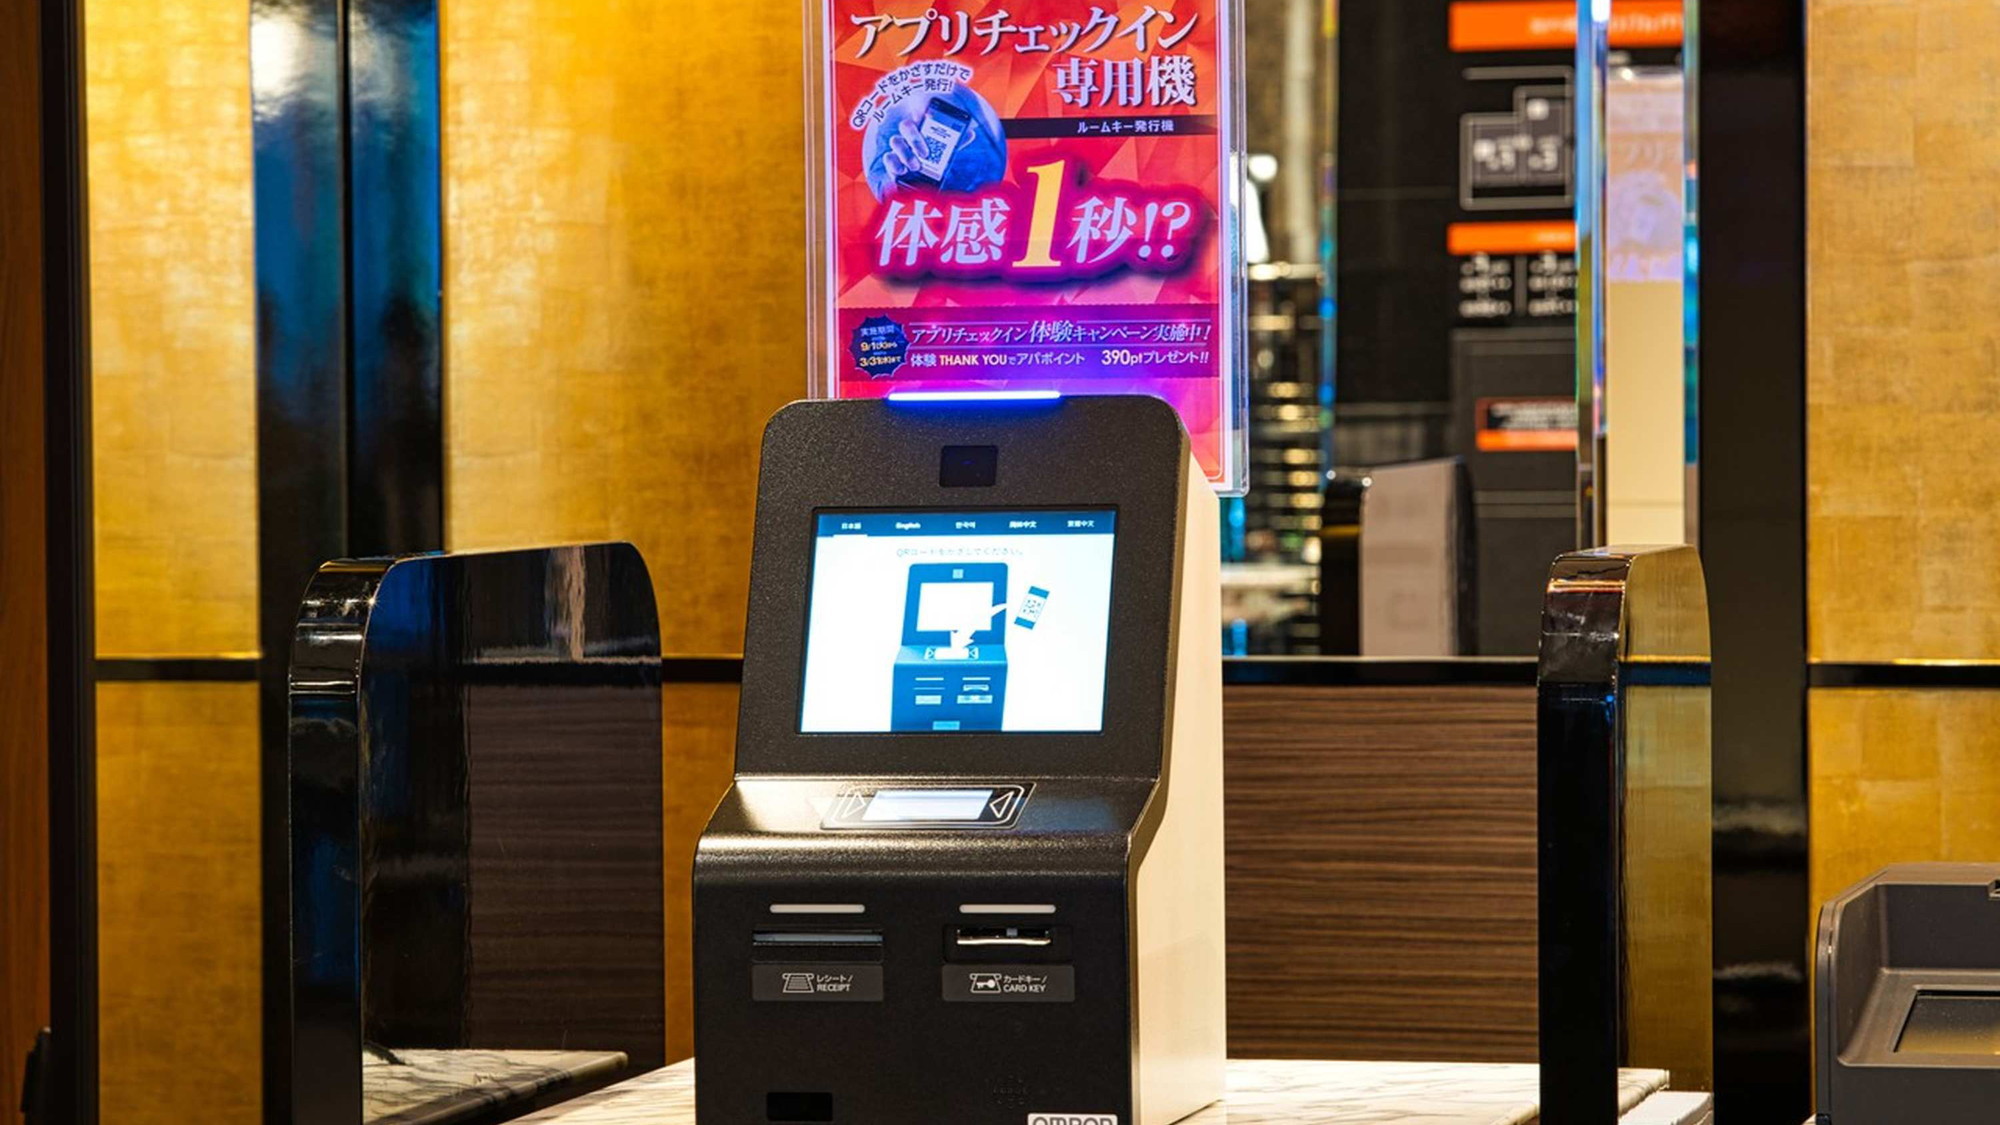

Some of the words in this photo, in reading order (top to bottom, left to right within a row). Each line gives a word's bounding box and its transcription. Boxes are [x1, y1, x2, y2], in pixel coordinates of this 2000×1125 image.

[850, 5, 1199, 58] アプリチェックイン
[1050, 55, 1197, 108] 専用機
[852, 62, 971, 128] QRコードをかざすだけで
[872, 78, 953, 122] ルームキー発行!
[1077, 119, 1174, 134] ルームキー発行機
[939, 353, 980, 366] THANK
[895, 521, 921, 531] English
[816, 983, 851, 992] RECEIPT
[1003, 984, 1027, 993] CARD
[1029, 984, 1046, 993] KEY
